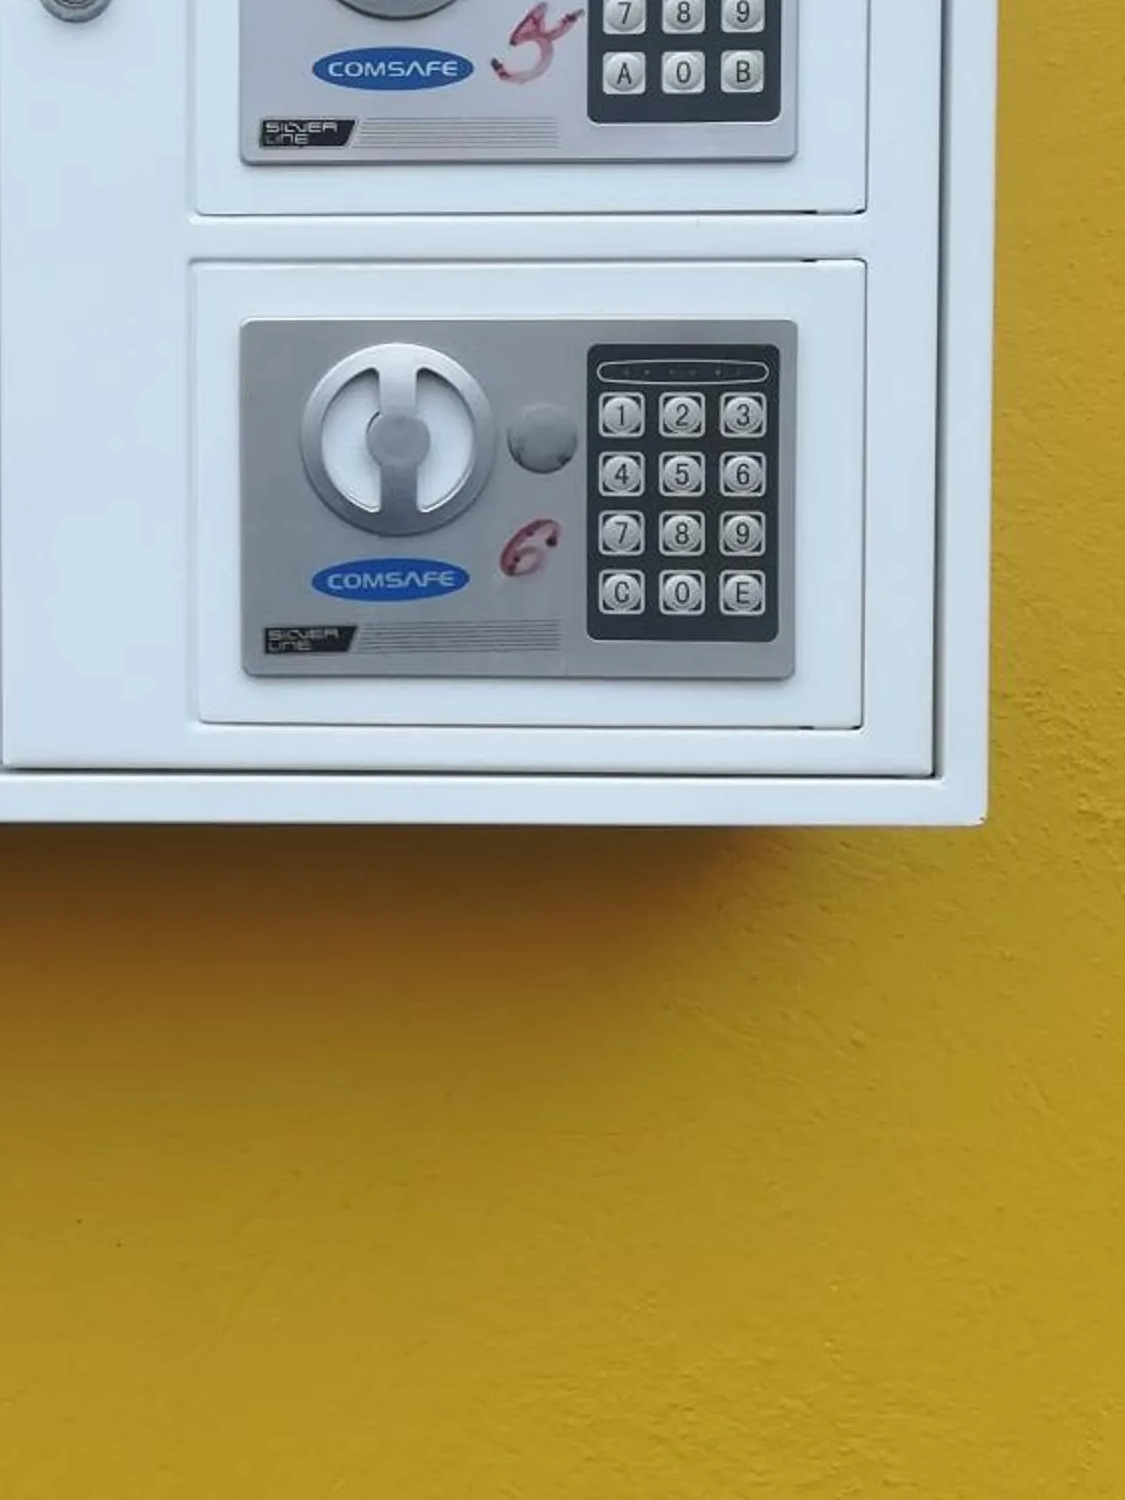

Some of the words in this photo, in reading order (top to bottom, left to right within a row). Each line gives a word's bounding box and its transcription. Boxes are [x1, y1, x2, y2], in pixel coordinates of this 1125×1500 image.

[619, 2, 632, 24] 7
[677, 2, 691, 23] 8
[737, 1, 750, 22] 9
[490, 2, 585, 84] 5
[328, 61, 458, 77] COMSAFE
[617, 62, 632, 84] A
[677, 62, 691, 83] 0
[736, 61, 751, 82] B
[266, 123, 337, 133] SILVER
[676, 404, 689, 426] 2
[737, 404, 749, 426] 3
[615, 464, 629, 484] 4
[675, 464, 689, 485] 5
[737, 464, 749, 485] 6
[615, 522, 627, 544] 7
[675, 522, 689, 544] 8
[737, 522, 749, 544] 9
[500, 519, 561, 577] 6
[328, 571, 456, 589] COMSAFE
[615, 582, 629, 604] C
[675, 582, 689, 604] 0
[736, 582, 749, 604] E
[268, 630, 339, 640] SILVER
